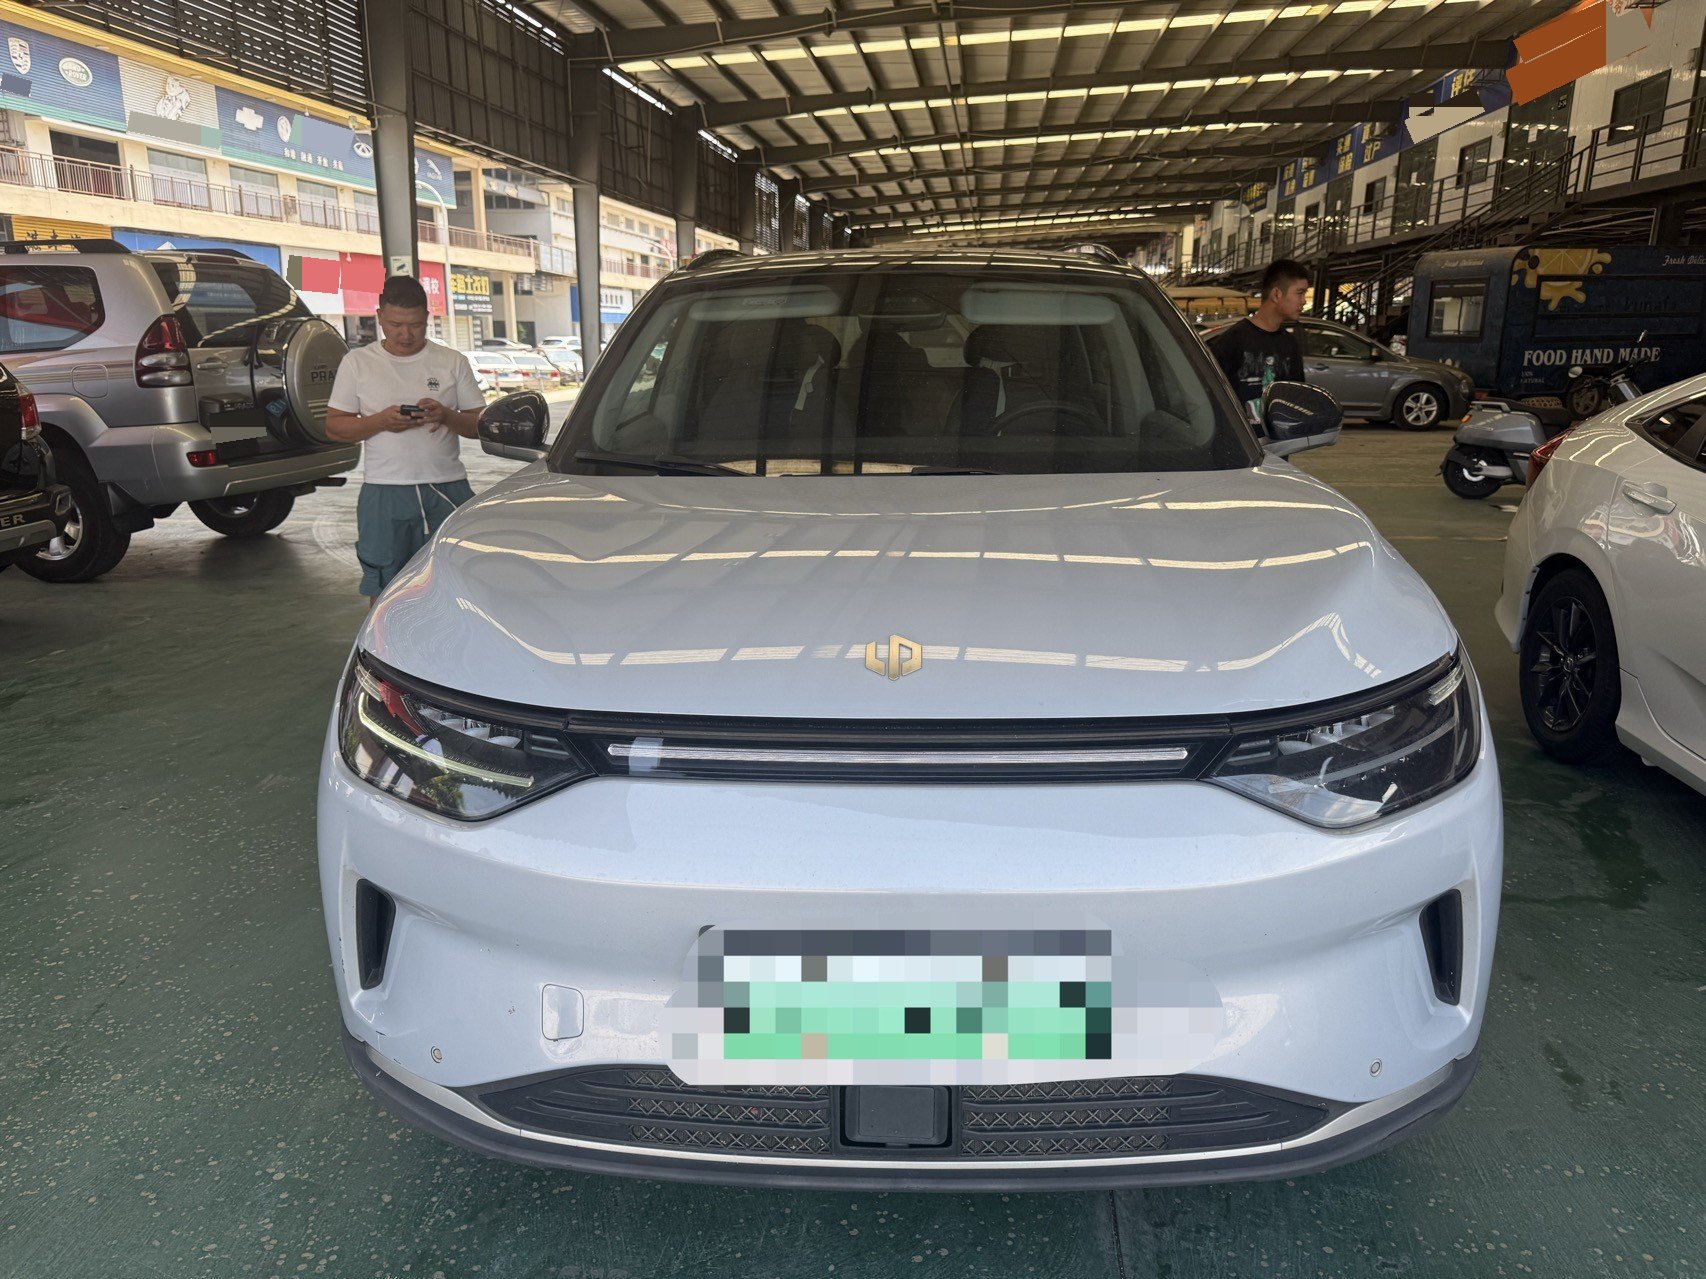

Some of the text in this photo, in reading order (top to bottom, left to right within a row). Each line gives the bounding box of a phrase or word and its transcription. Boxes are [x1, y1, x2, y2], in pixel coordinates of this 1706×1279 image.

[1522, 346, 1661, 367] FOOD HAND MADE
[310, 370, 336, 383] PRA
